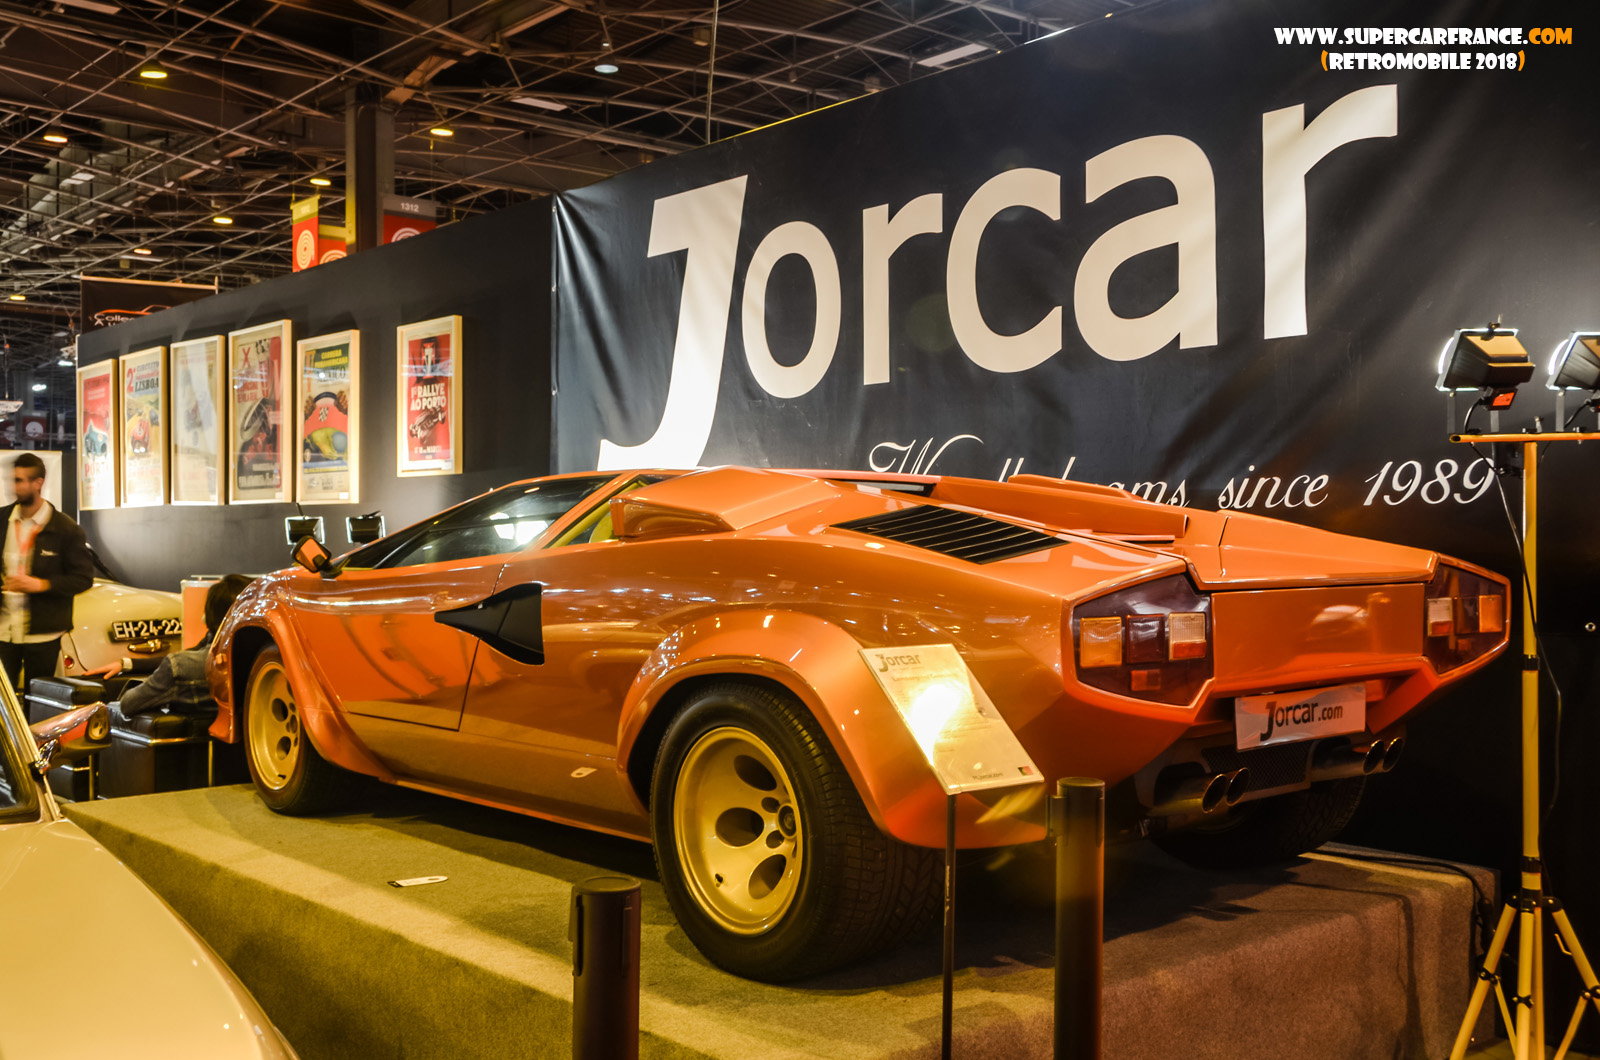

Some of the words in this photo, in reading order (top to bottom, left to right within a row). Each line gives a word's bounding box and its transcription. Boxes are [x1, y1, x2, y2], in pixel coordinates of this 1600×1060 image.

[400, 202, 420, 212] 1312
[600, 84, 1398, 470] Jorcar
[134, 377, 159, 392] LISBOA
[417, 383, 445, 398] RALLYE
[422, 396, 447, 410] PORTO
[1218, 465, 1329, 509] since
[1363, 457, 1497, 506] 1989
[875, 653, 921, 672] Jorcar
[1260, 700, 1343, 741] Jorcar.com
